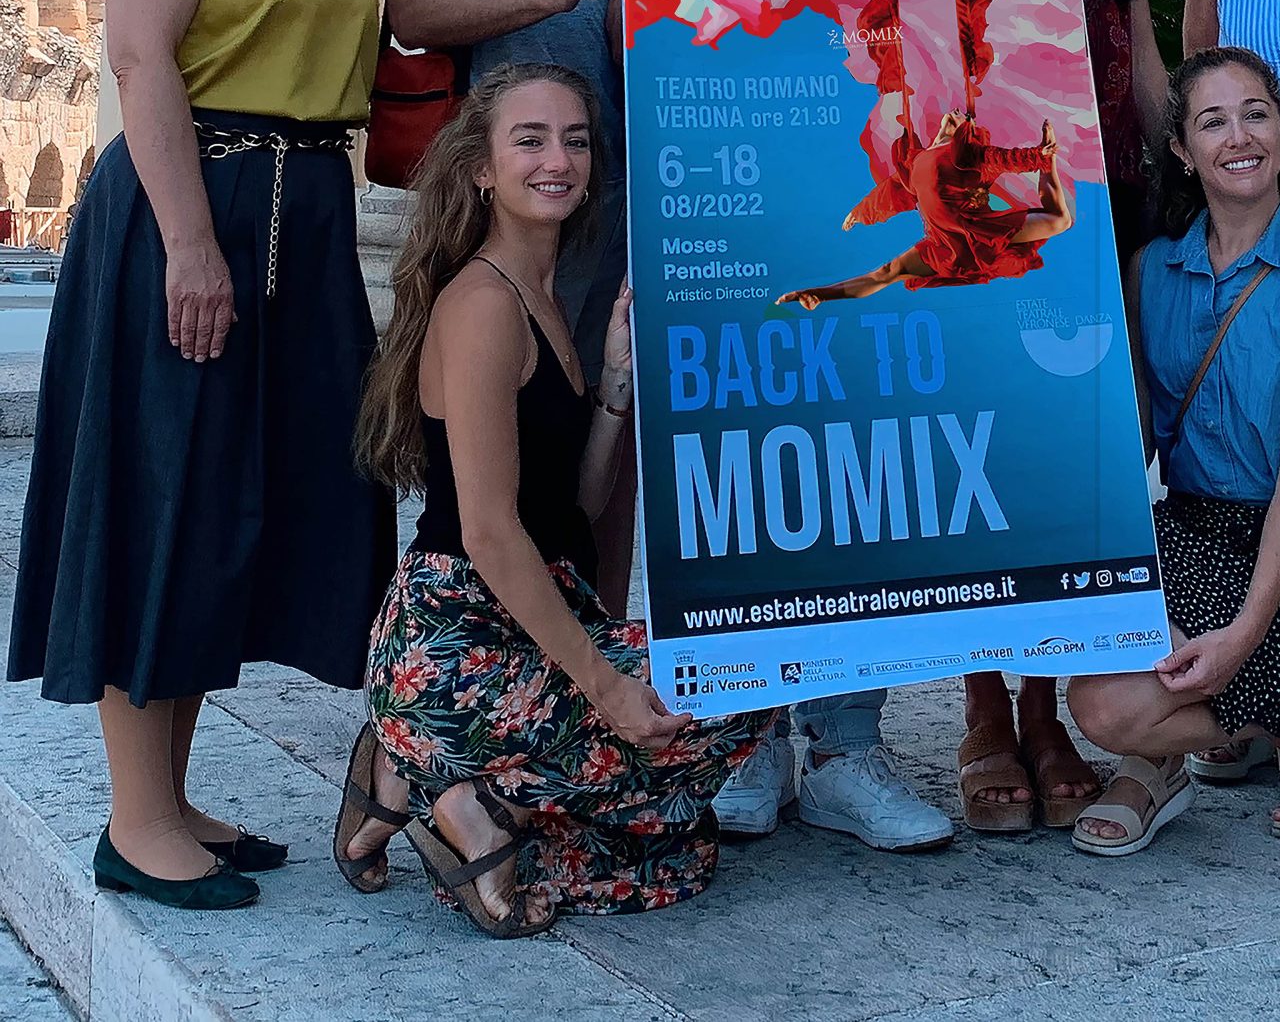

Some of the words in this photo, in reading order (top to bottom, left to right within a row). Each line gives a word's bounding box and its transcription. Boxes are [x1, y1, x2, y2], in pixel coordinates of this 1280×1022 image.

[842, 25, 904, 45] MOMIX
[655, 76, 736, 100] TEATRO
[744, 74, 840, 99] ROMANO
[655, 105, 744, 128] VERONA
[751, 111, 783, 127] ore
[789, 106, 841, 127] 21.30
[660, 193, 764, 219] 08/2022
[662, 238, 729, 255] Moses
[664, 260, 768, 280] Pendleton
[665, 288, 713, 303] Artistic
[716, 286, 769, 300] Director
[1015, 297, 1049, 310] ESTATE
[1016, 307, 1064, 320] TEATRALE
[1075, 312, 1112, 326] DANZA
[1017, 317, 1071, 330] VERONESE
[667, 316, 847, 412] BACK
[860, 310, 946, 397] TO
[672, 410, 1010, 560] MOMIX
[683, 575, 1017, 629] www.estateteatraleveronese.it
[1116, 629, 1163, 644] CATTOLICA
[969, 646, 1014, 660] arteven
[1024, 645, 1062, 657] BANCO
[1064, 642, 1086, 654] BPM
[700, 661, 756, 677] Comune
[801, 657, 844, 669] MINISTERO
[876, 662, 913, 673] REGIONE
[926, 657, 961, 668] VENETO
[802, 667, 824, 676] DELLA
[804, 671, 847, 682] CULTURA
[701, 680, 714, 694] di
[717, 678, 767, 692] Verona
[675, 701, 703, 711] Cultura
